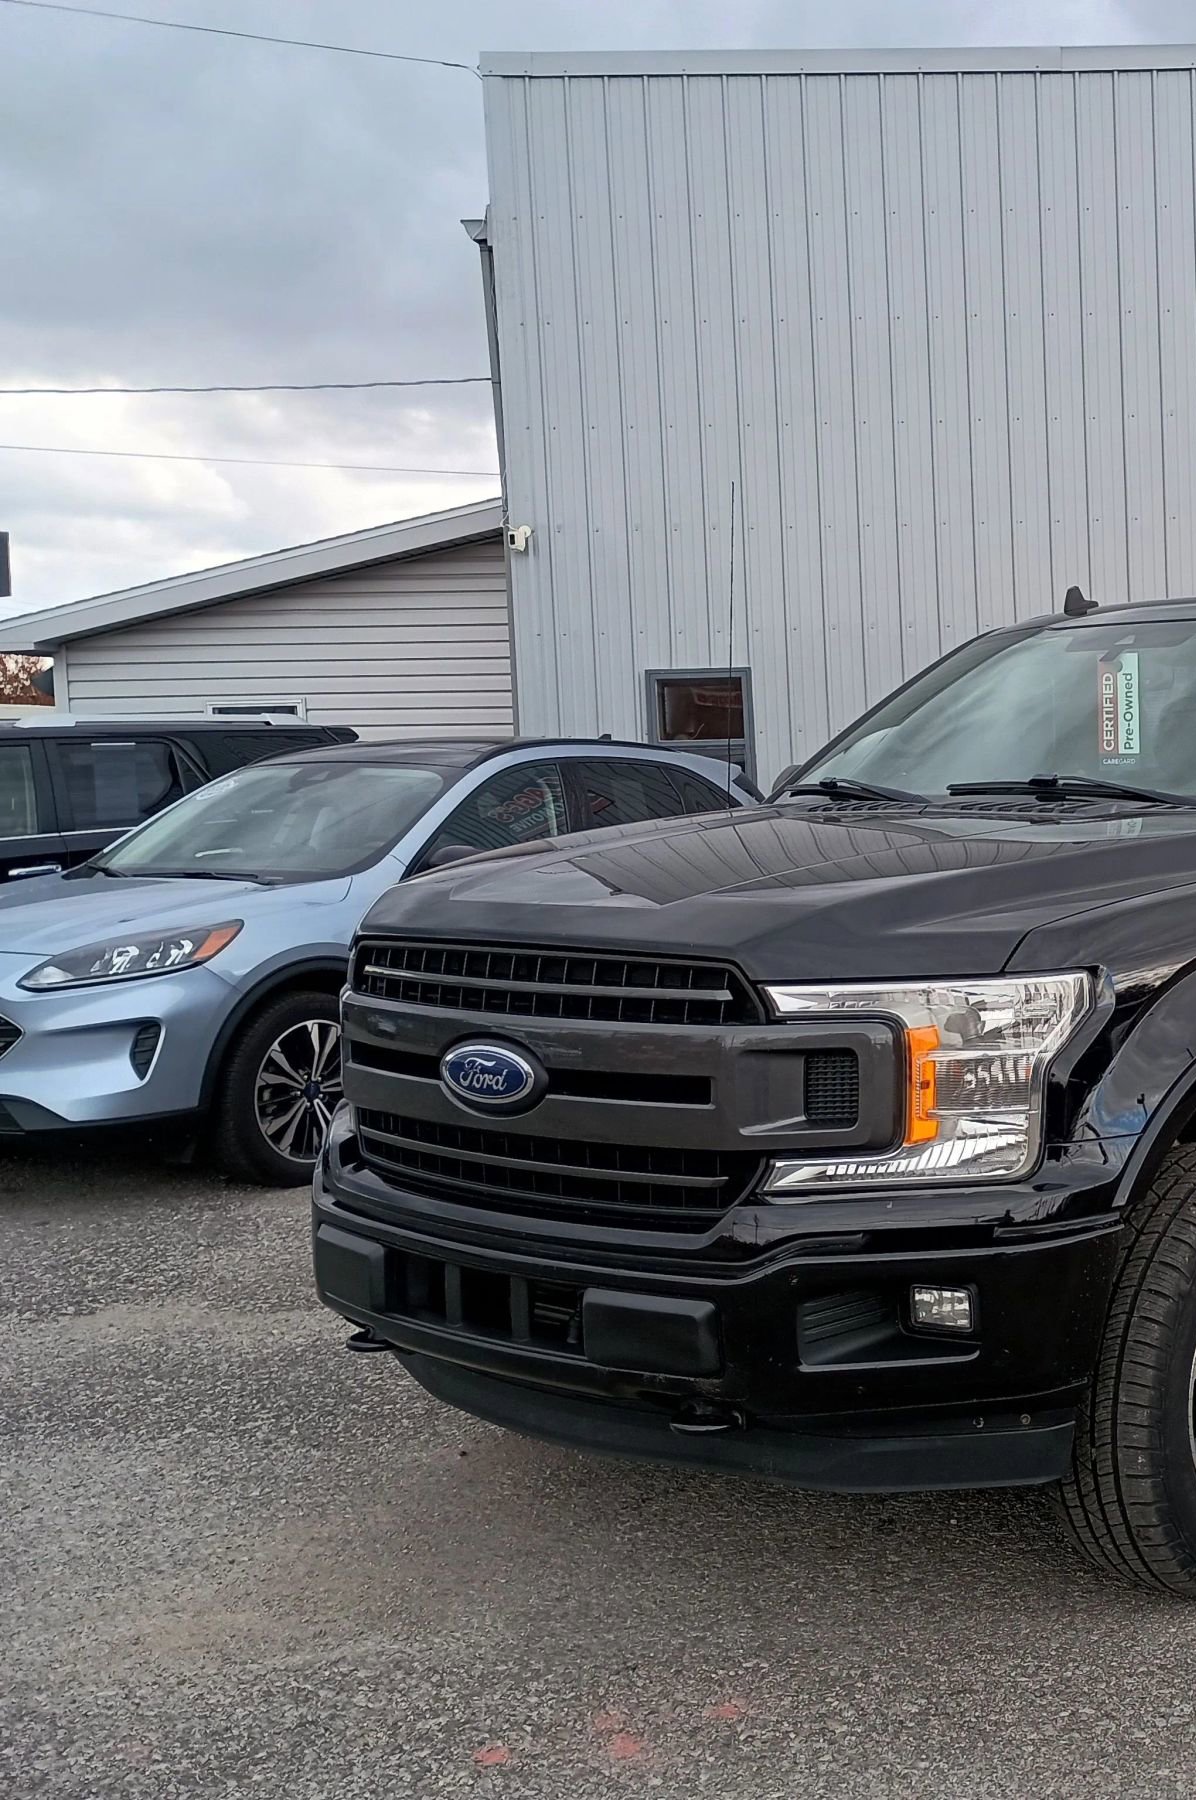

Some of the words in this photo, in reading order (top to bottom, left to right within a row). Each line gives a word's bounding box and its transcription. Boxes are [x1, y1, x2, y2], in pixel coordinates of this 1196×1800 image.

[1102, 672, 1115, 751] CERTIFIED
[1122, 672, 1135, 750] Pre-Owned
[460, 1057, 509, 1091] Ford
